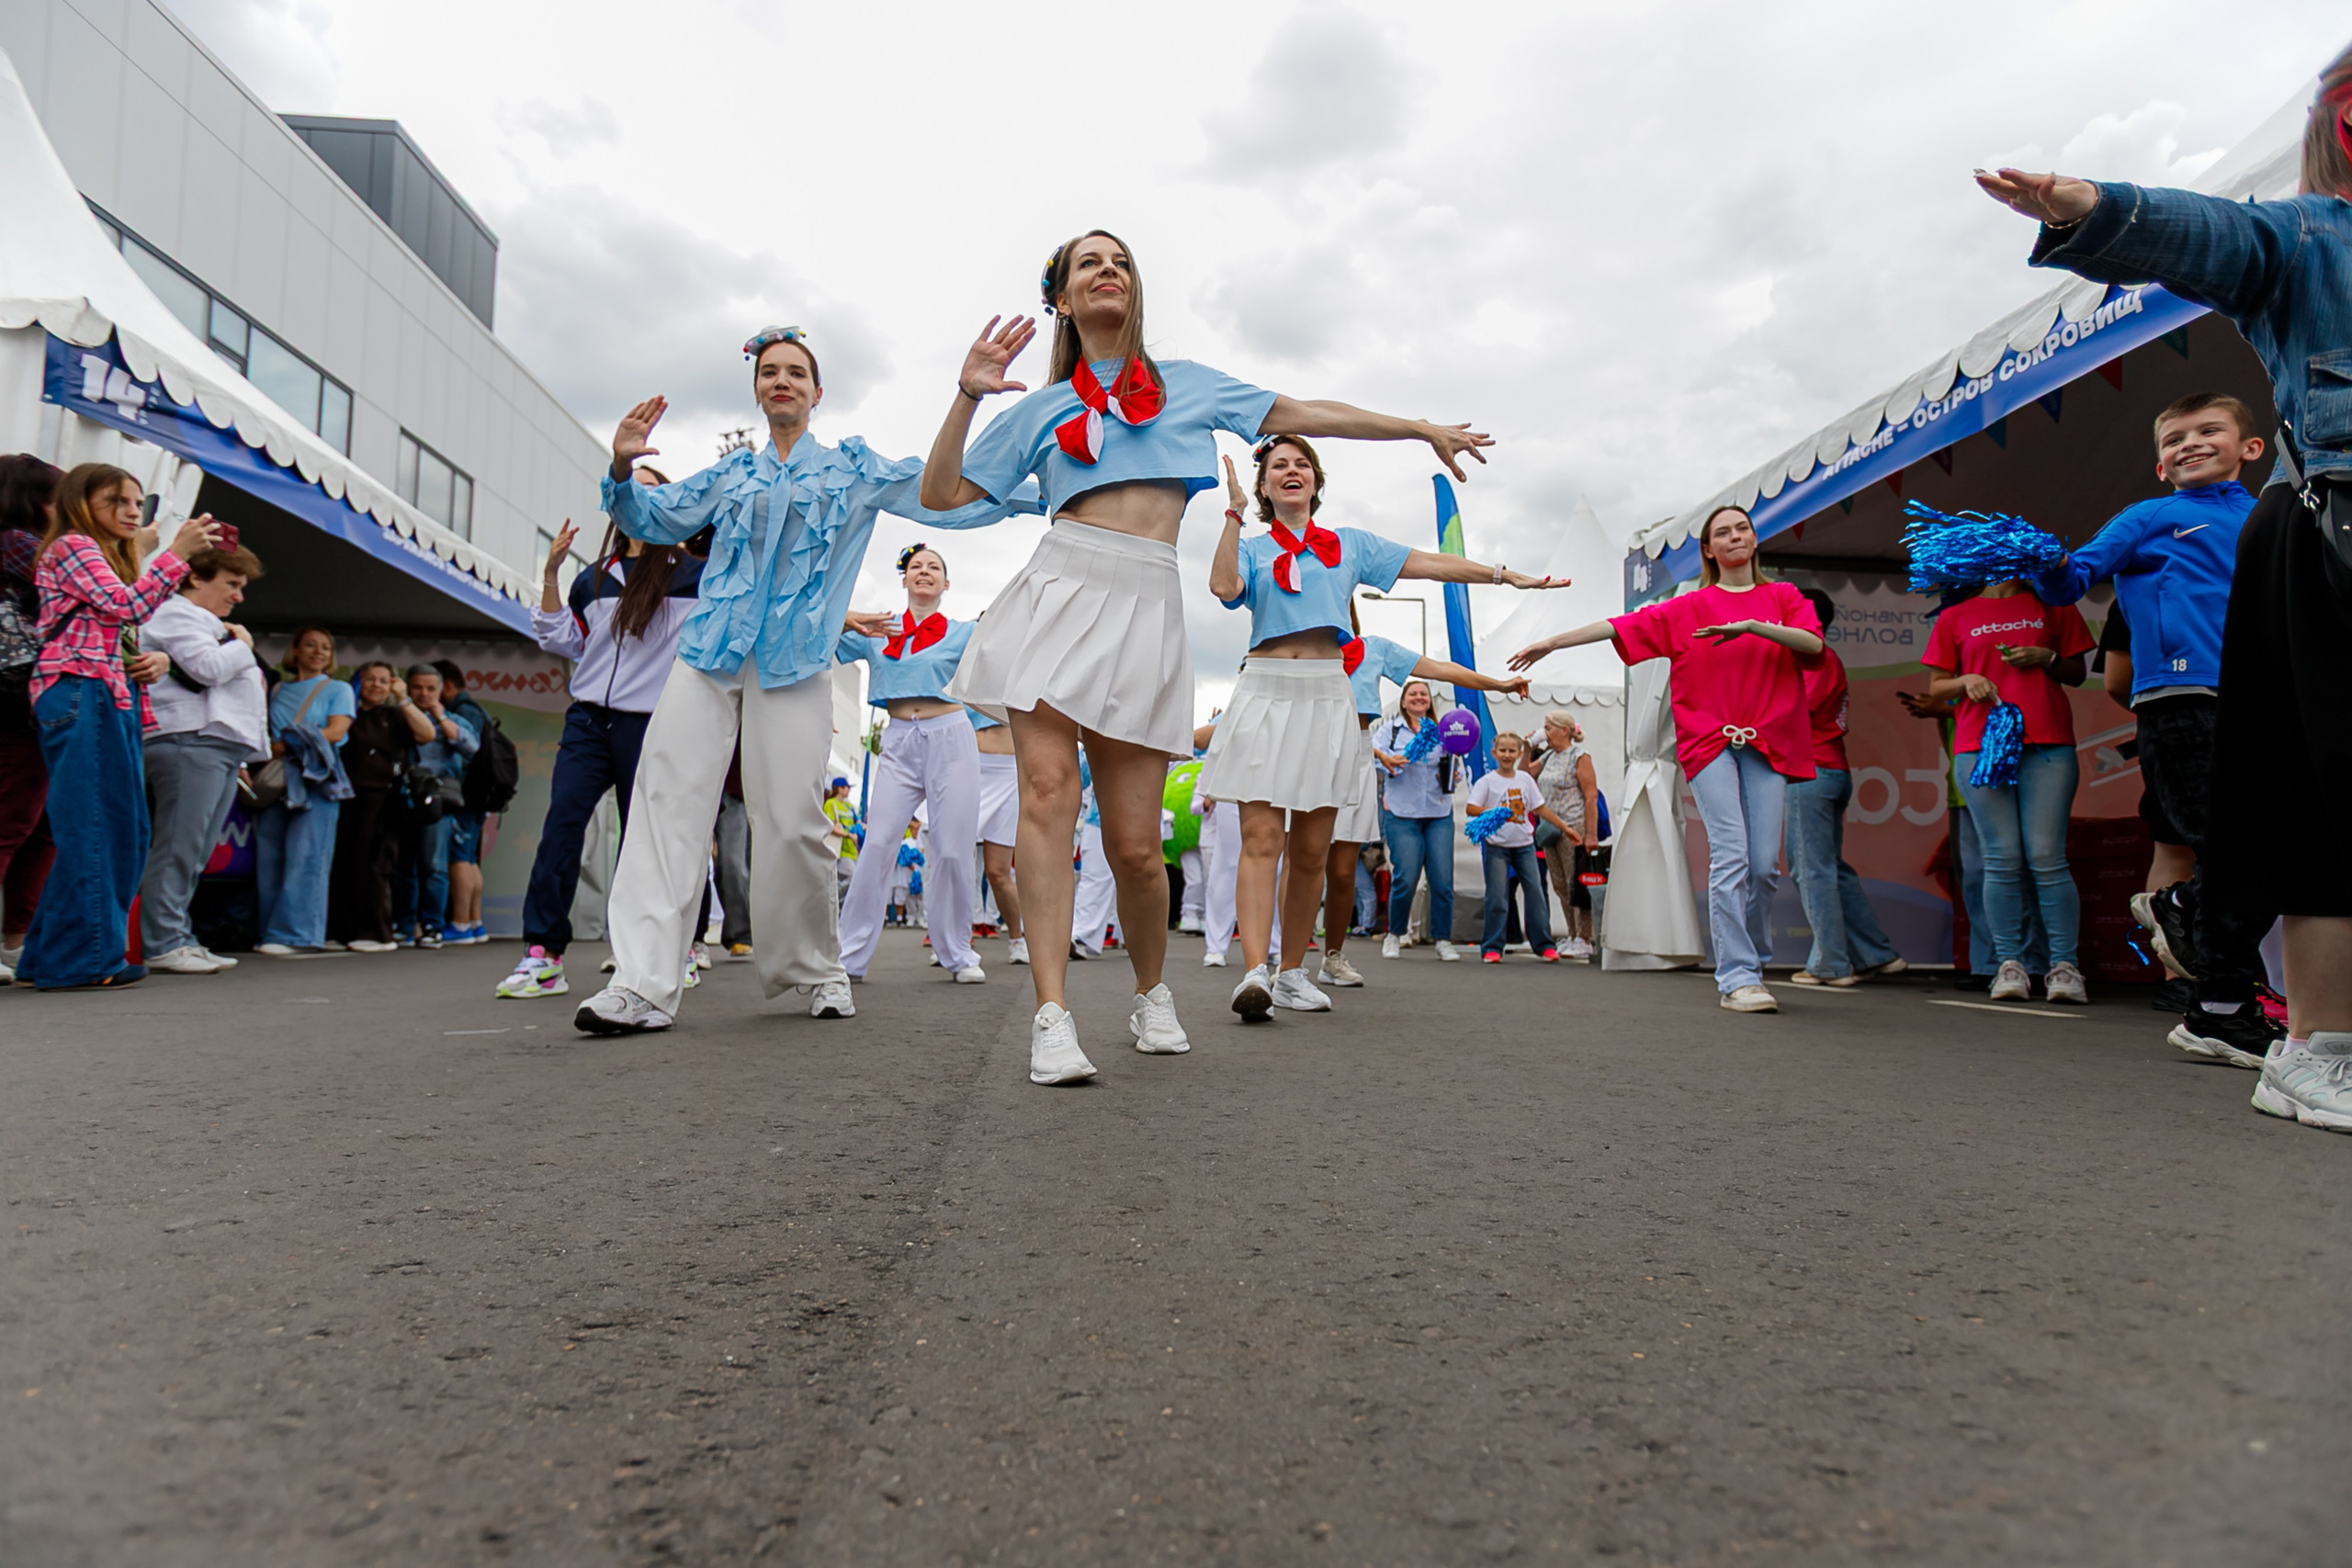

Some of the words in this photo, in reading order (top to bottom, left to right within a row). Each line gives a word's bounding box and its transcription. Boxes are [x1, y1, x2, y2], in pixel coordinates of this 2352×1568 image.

[1913, 373, 1994, 429] ОСТРОВ
[1998, 289, 2143, 382] СОКРОВИЩ
[80, 353, 147, 422] 14
[1633, 563, 1648, 593] 4
[1970, 617, 2044, 637] attaché
[2172, 659, 2188, 671] 18
